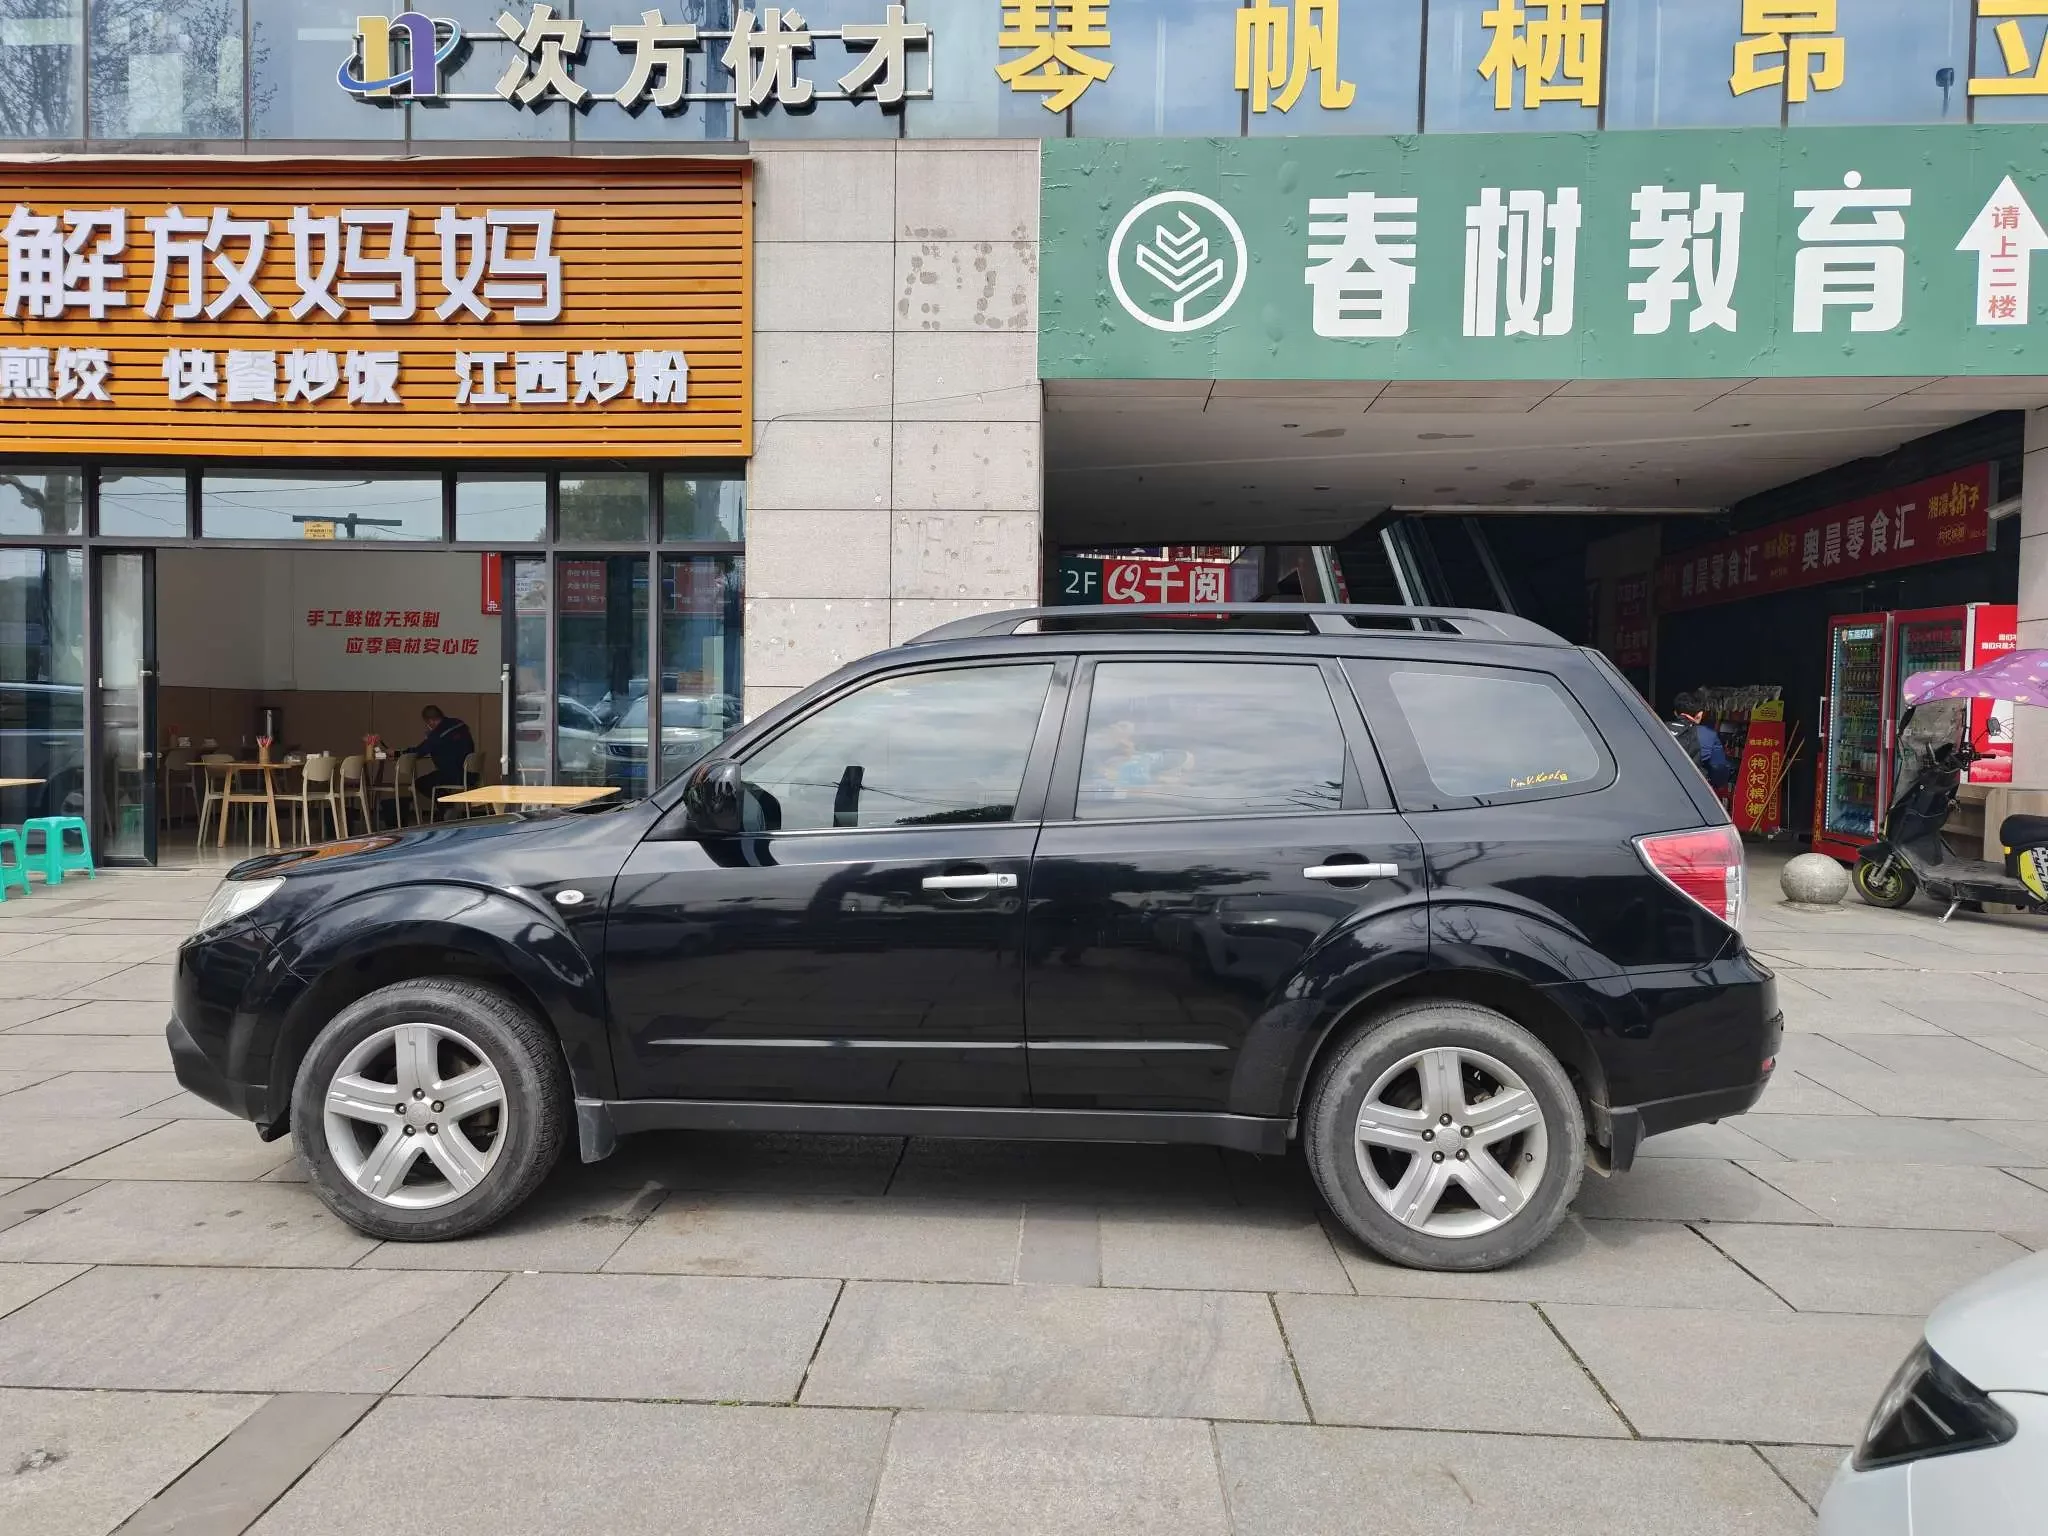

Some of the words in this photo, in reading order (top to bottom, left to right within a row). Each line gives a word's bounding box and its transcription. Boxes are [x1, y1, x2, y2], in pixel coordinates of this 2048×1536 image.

[495, 3, 928, 108] 次方优才
[1, 204, 565, 322] 解放妈妈
[1304, 170, 1912, 338] 春树教育
[1988, 205, 2021, 319] 请上二楼
[0, 346, 114, 401] 煎饺
[162, 347, 401, 403] 快餐炒饭
[455, 348, 690, 405] 江西炒粉
[1802, 503, 1916, 573] 奥晨零食汇
[1065, 569, 1097, 594] 2F
[307, 610, 440, 628] 手工鲜做无预制
[346, 637, 479, 655] 应季食材安心吃
